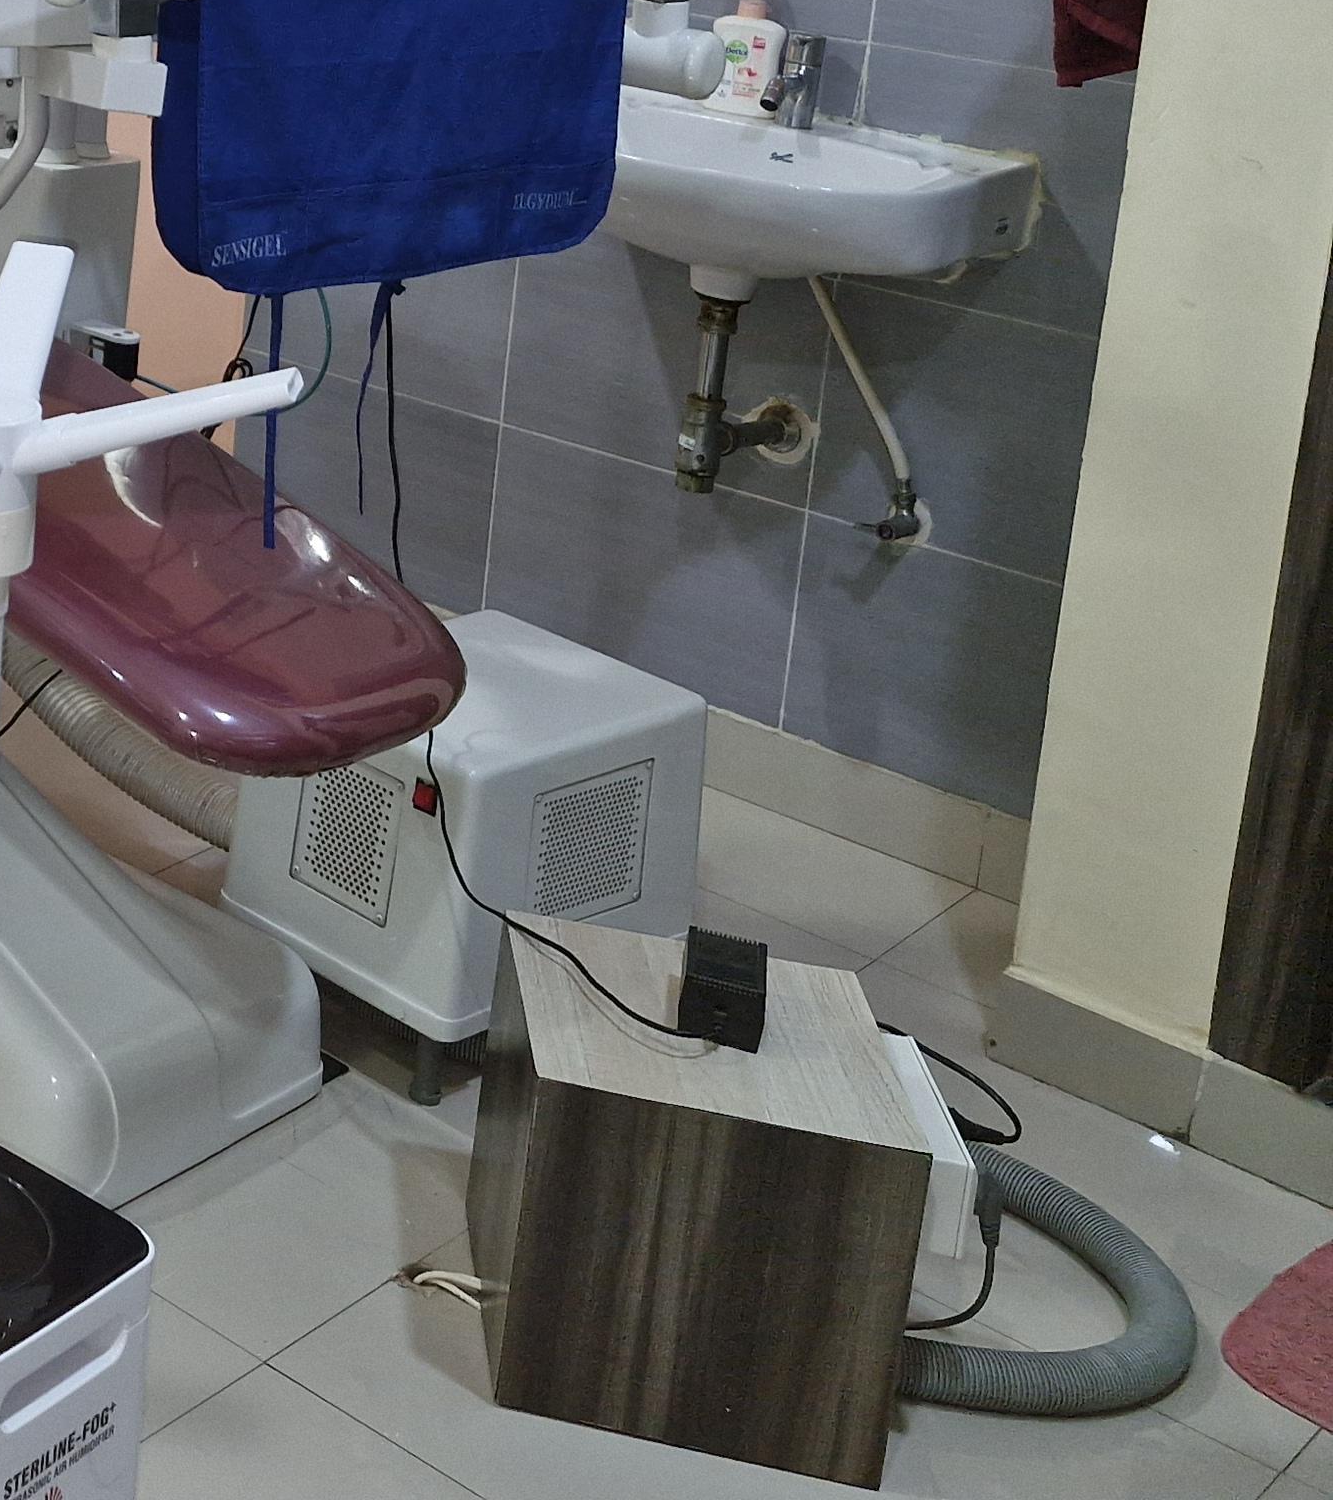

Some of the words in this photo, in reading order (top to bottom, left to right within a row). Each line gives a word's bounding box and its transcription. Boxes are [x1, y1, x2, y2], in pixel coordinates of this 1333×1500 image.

[212, 233, 287, 268] SENSIGEL
[53, 1461, 67, 1478] AIR
[68, 1424, 115, 1467] HUMIDIFIER
